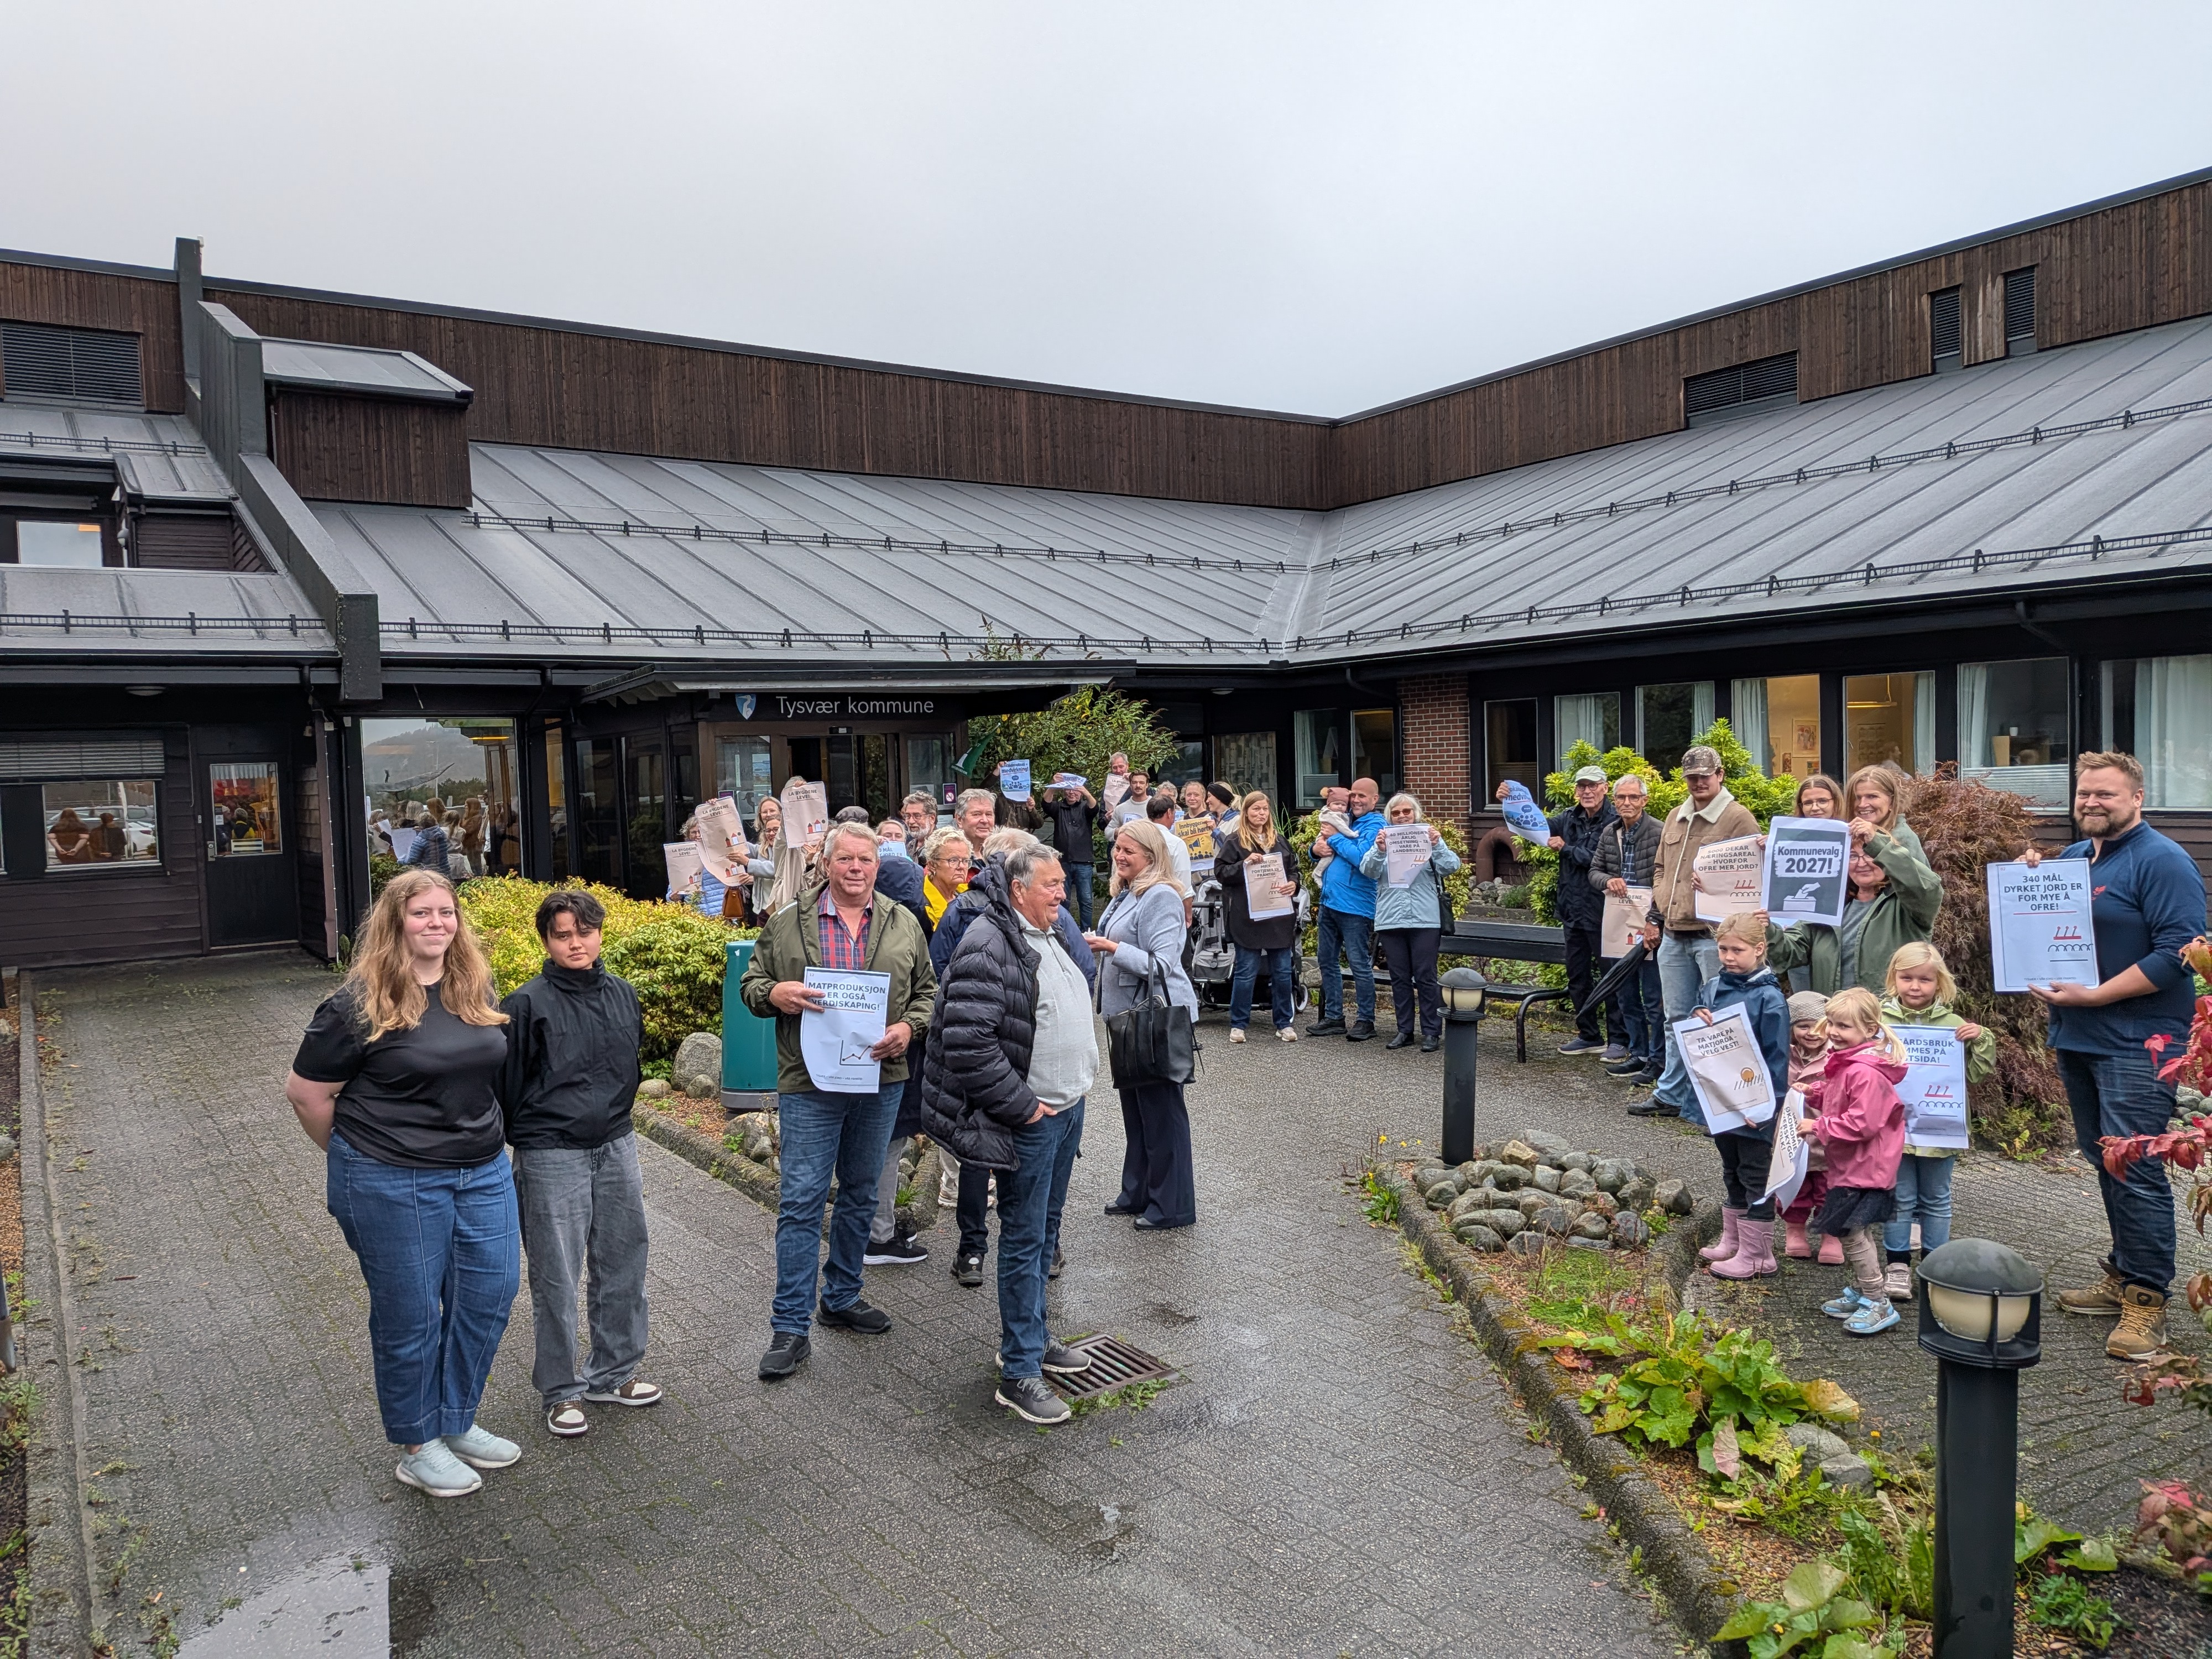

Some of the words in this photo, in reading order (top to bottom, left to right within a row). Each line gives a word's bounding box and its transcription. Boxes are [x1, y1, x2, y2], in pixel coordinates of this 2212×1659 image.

[775, 696, 841, 718] Tysvær
[848, 696, 934, 713] kommune
[709, 804, 729, 813] BYGDENE
[1700, 851, 1756, 859] NÆRINGSAREAL
[1777, 846, 1839, 858] Kommunevalg
[1785, 857, 1833, 875] 2027!
[2022, 875, 2039, 883] 340
[2043, 873, 2064, 882] MÅL
[2004, 885, 2041, 893] DYRKET
[2043, 884, 2068, 893] JORD
[2063, 891, 2070, 900] Å
[2031, 903, 2059, 911] OFRE!
[808, 982, 886, 994] MATPRODUKSJON
[842, 993, 866, 1001] OGSÅ
[811, 999, 880, 1011] VERDISKAPING!
[1707, 1031, 1725, 1041] VARE
[1725, 1026, 1734, 1035] PÅ
[1698, 1036, 1733, 1051] MATJORDA
[1700, 1047, 1719, 1056] VELG
[1720, 1040, 1740, 1052] VEST!
[1900, 1037, 1955, 1047] ÅRDSBRUK
[1905, 1055, 1940, 1063] TSIDA!
[1785, 1106, 1798, 1152] ØKONOMIE
[1782, 1112, 1793, 1164] ERSKYGGE
